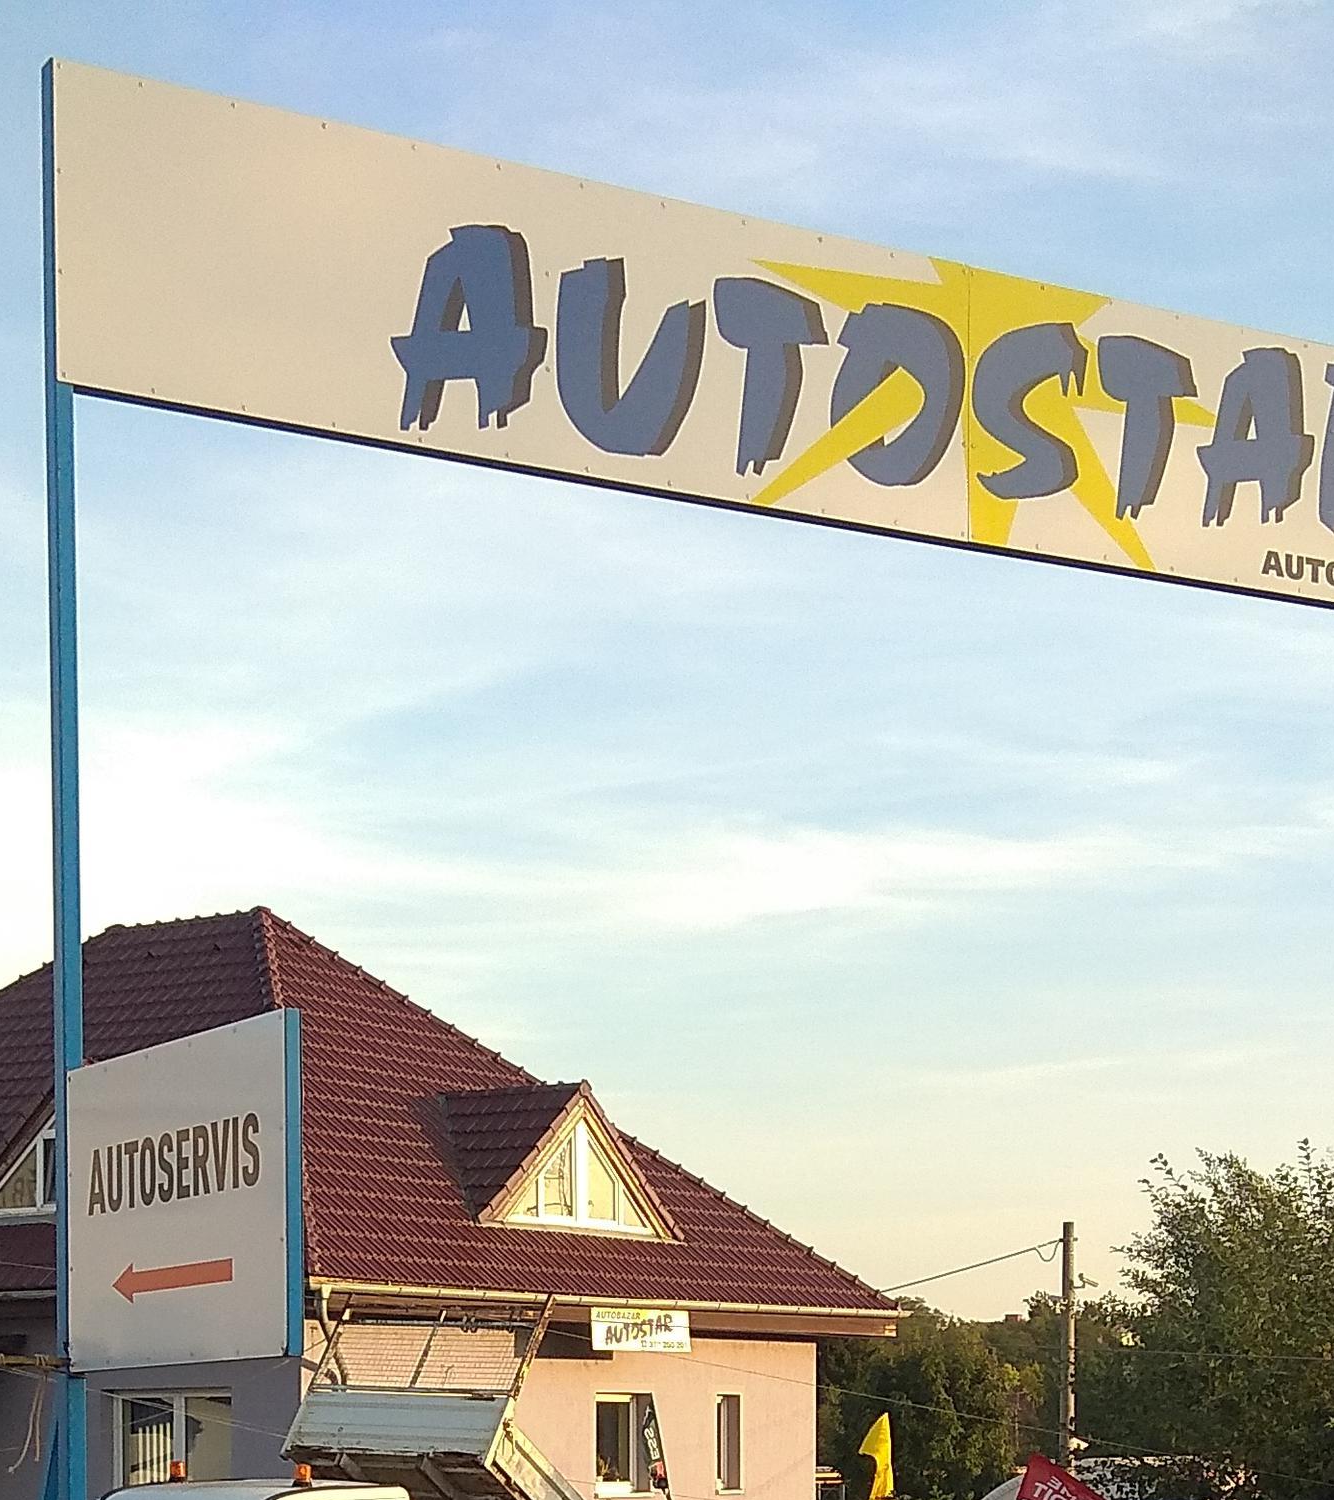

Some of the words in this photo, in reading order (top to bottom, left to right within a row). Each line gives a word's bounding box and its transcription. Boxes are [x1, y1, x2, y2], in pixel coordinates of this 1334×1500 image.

[87, 1112, 260, 1216] AUTOSERVIS
[595, 1311, 641, 1320] AUTOBAZAR
[605, 1314, 673, 1346] AUTOSTAR
